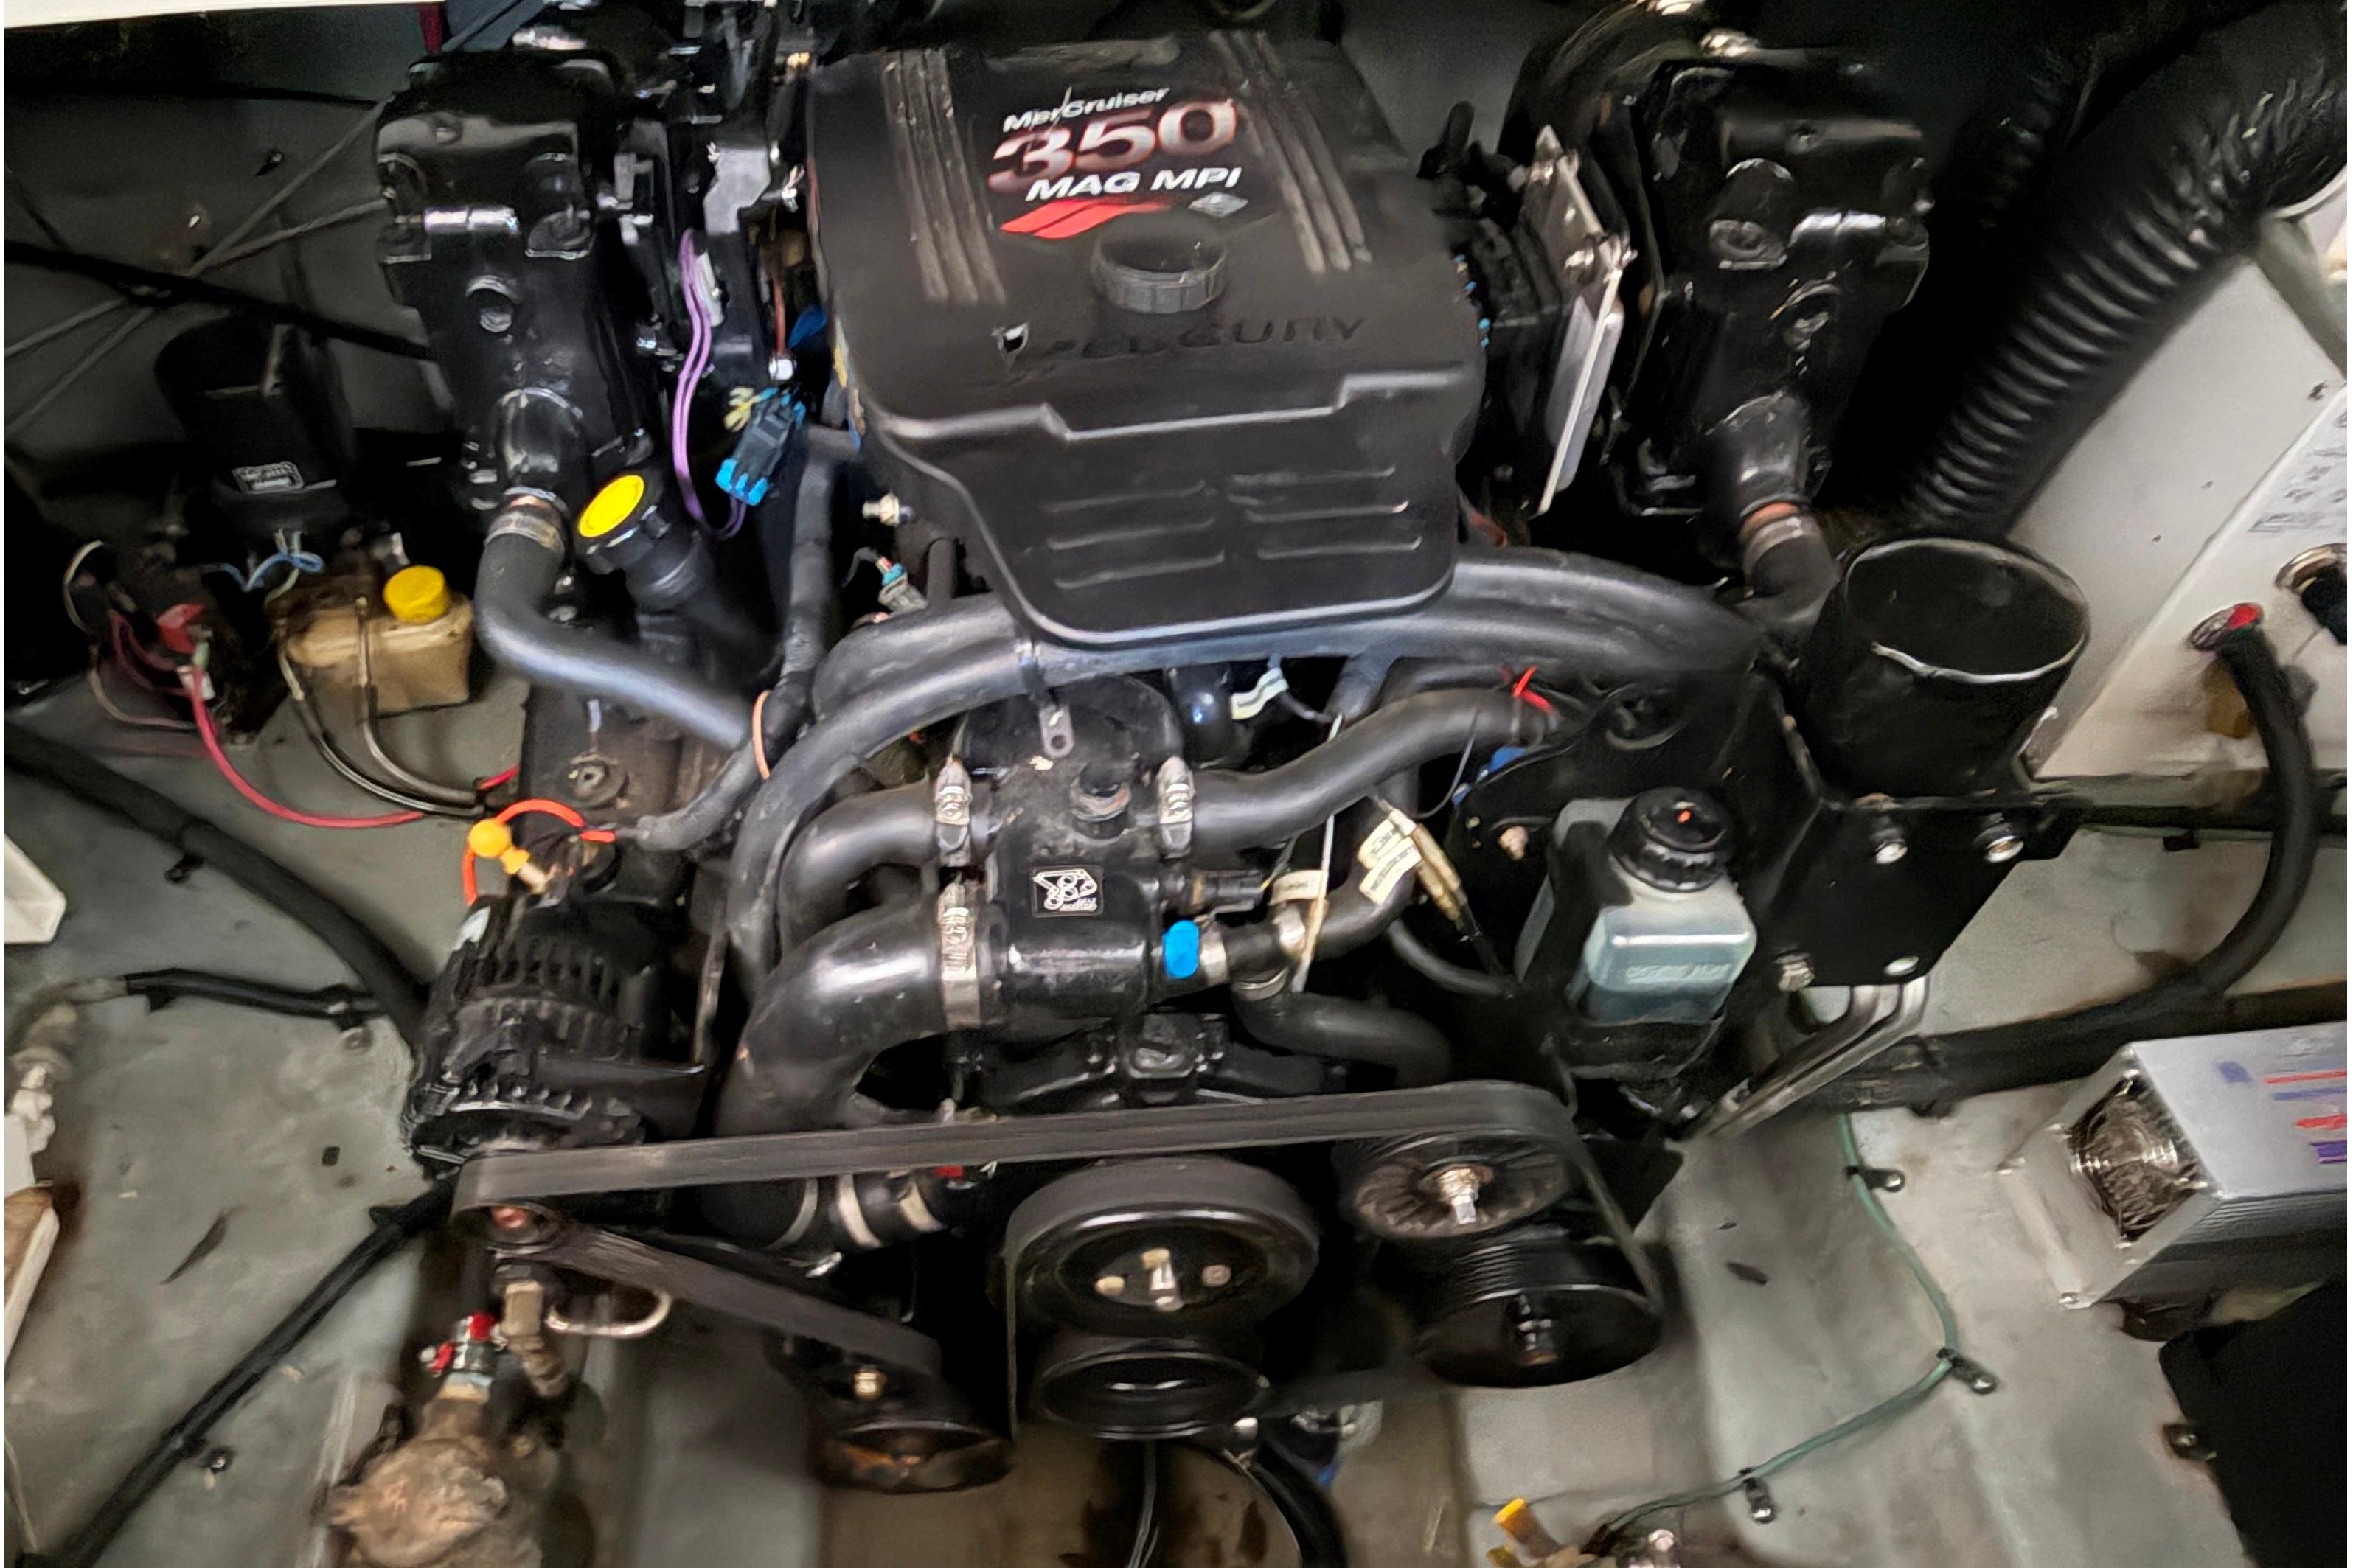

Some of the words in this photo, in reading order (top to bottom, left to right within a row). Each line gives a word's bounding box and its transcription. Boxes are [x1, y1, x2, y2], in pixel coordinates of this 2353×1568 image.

[1003, 87, 1170, 133] MerCruiser
[988, 98, 1237, 192] 350
[1025, 171, 1141, 202] MAG
[1150, 167, 1242, 192] MPI
